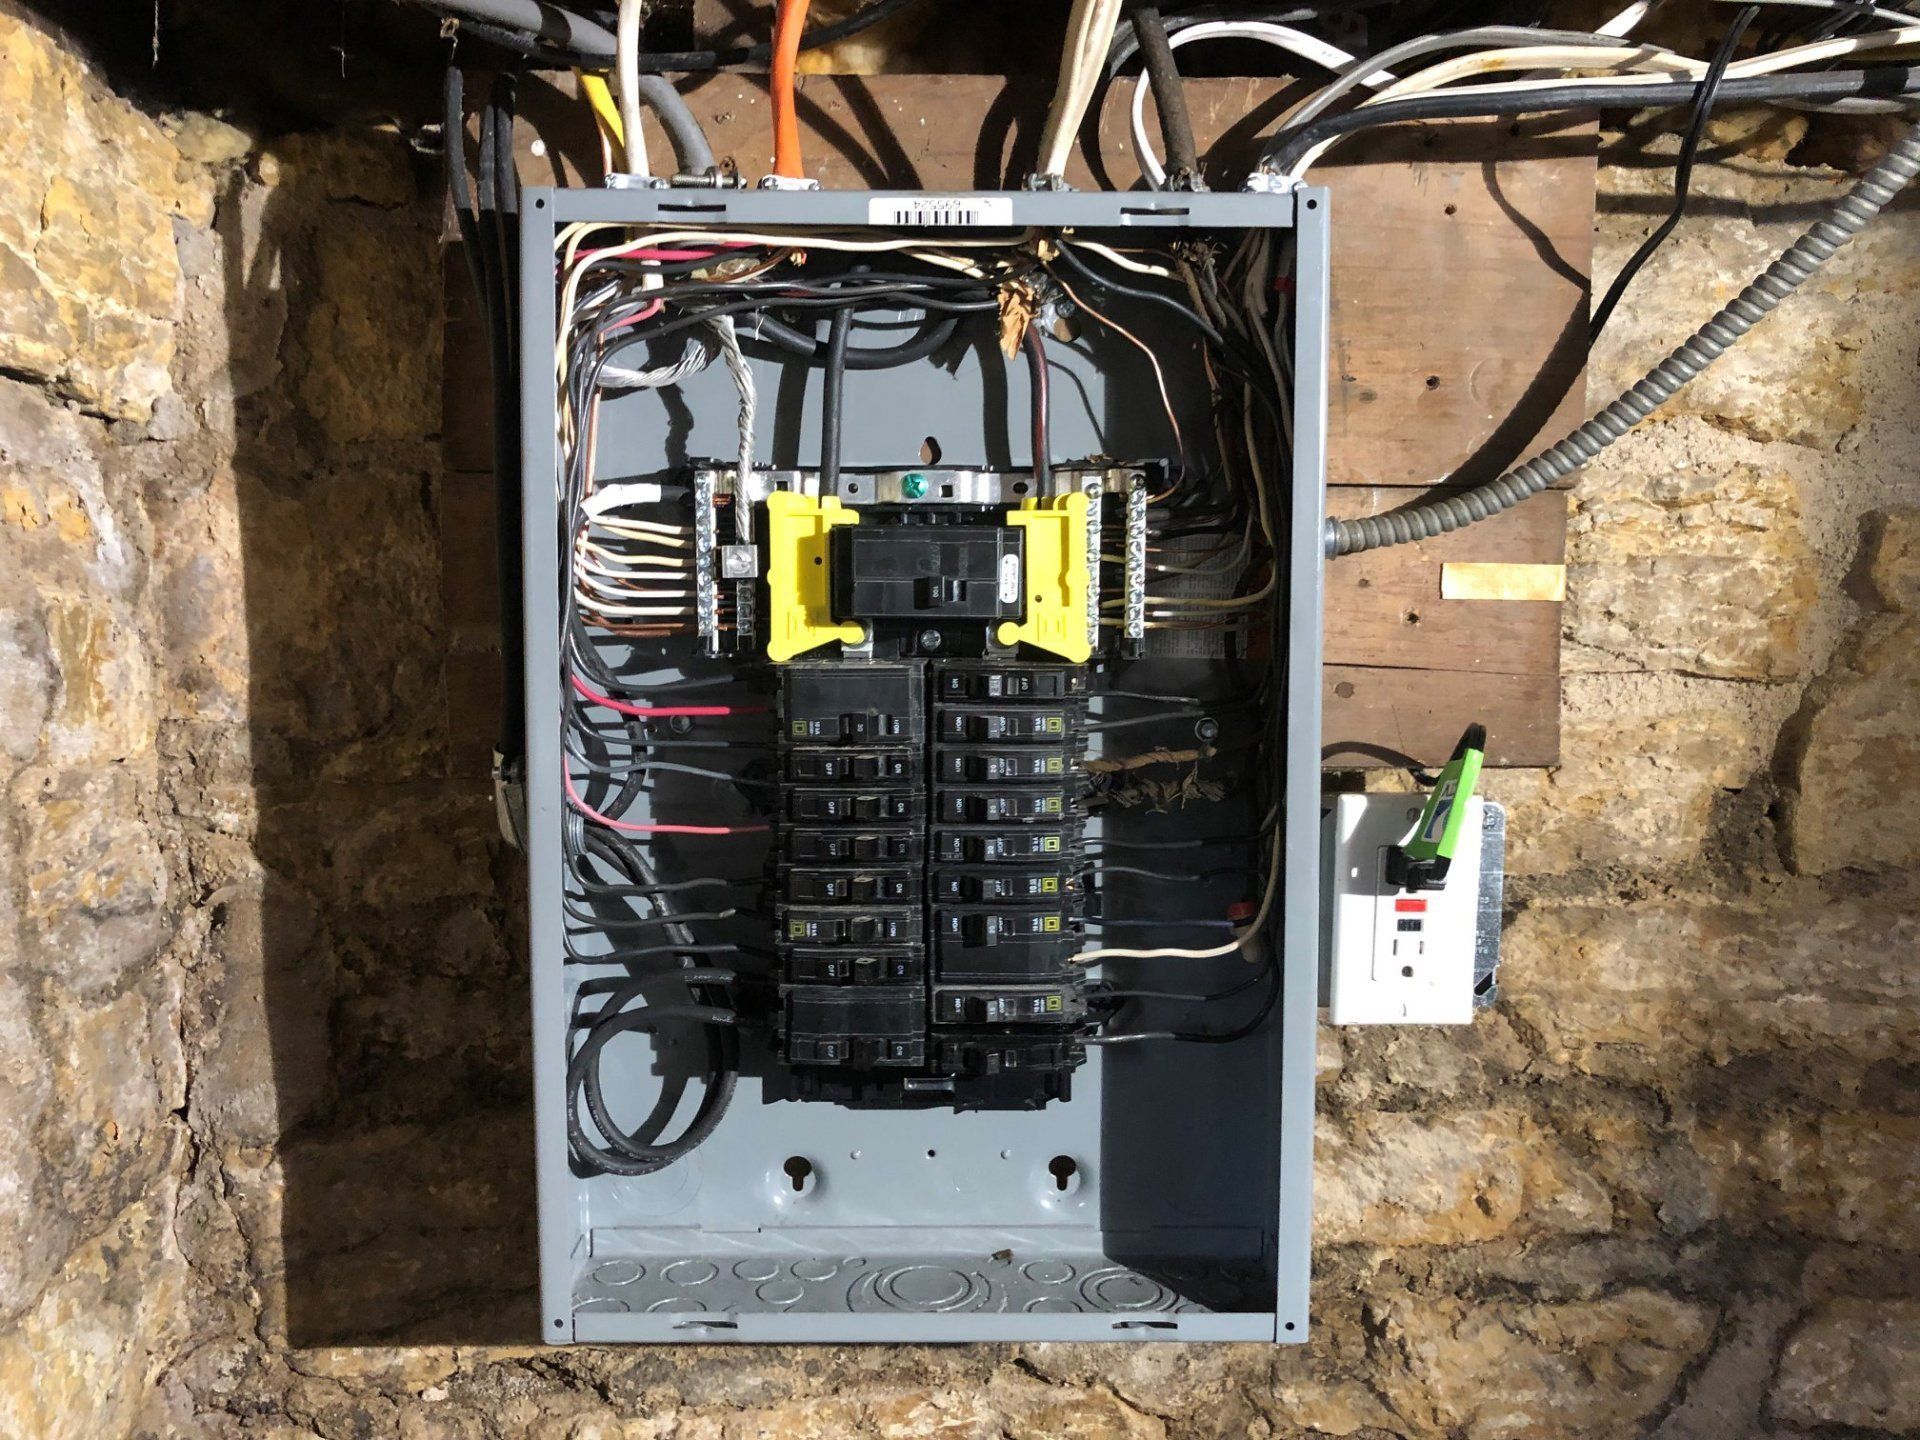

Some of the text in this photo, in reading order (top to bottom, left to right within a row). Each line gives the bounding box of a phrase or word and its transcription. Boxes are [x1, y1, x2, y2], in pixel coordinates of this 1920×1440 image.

[952, 678, 958, 689] ON
[896, 763, 902, 774] ON
[898, 803, 904, 813] ON
[896, 883, 902, 894] ON
[951, 882, 958, 892] ON
[897, 964, 904, 975] ON
[896, 1046, 903, 1056] ON
